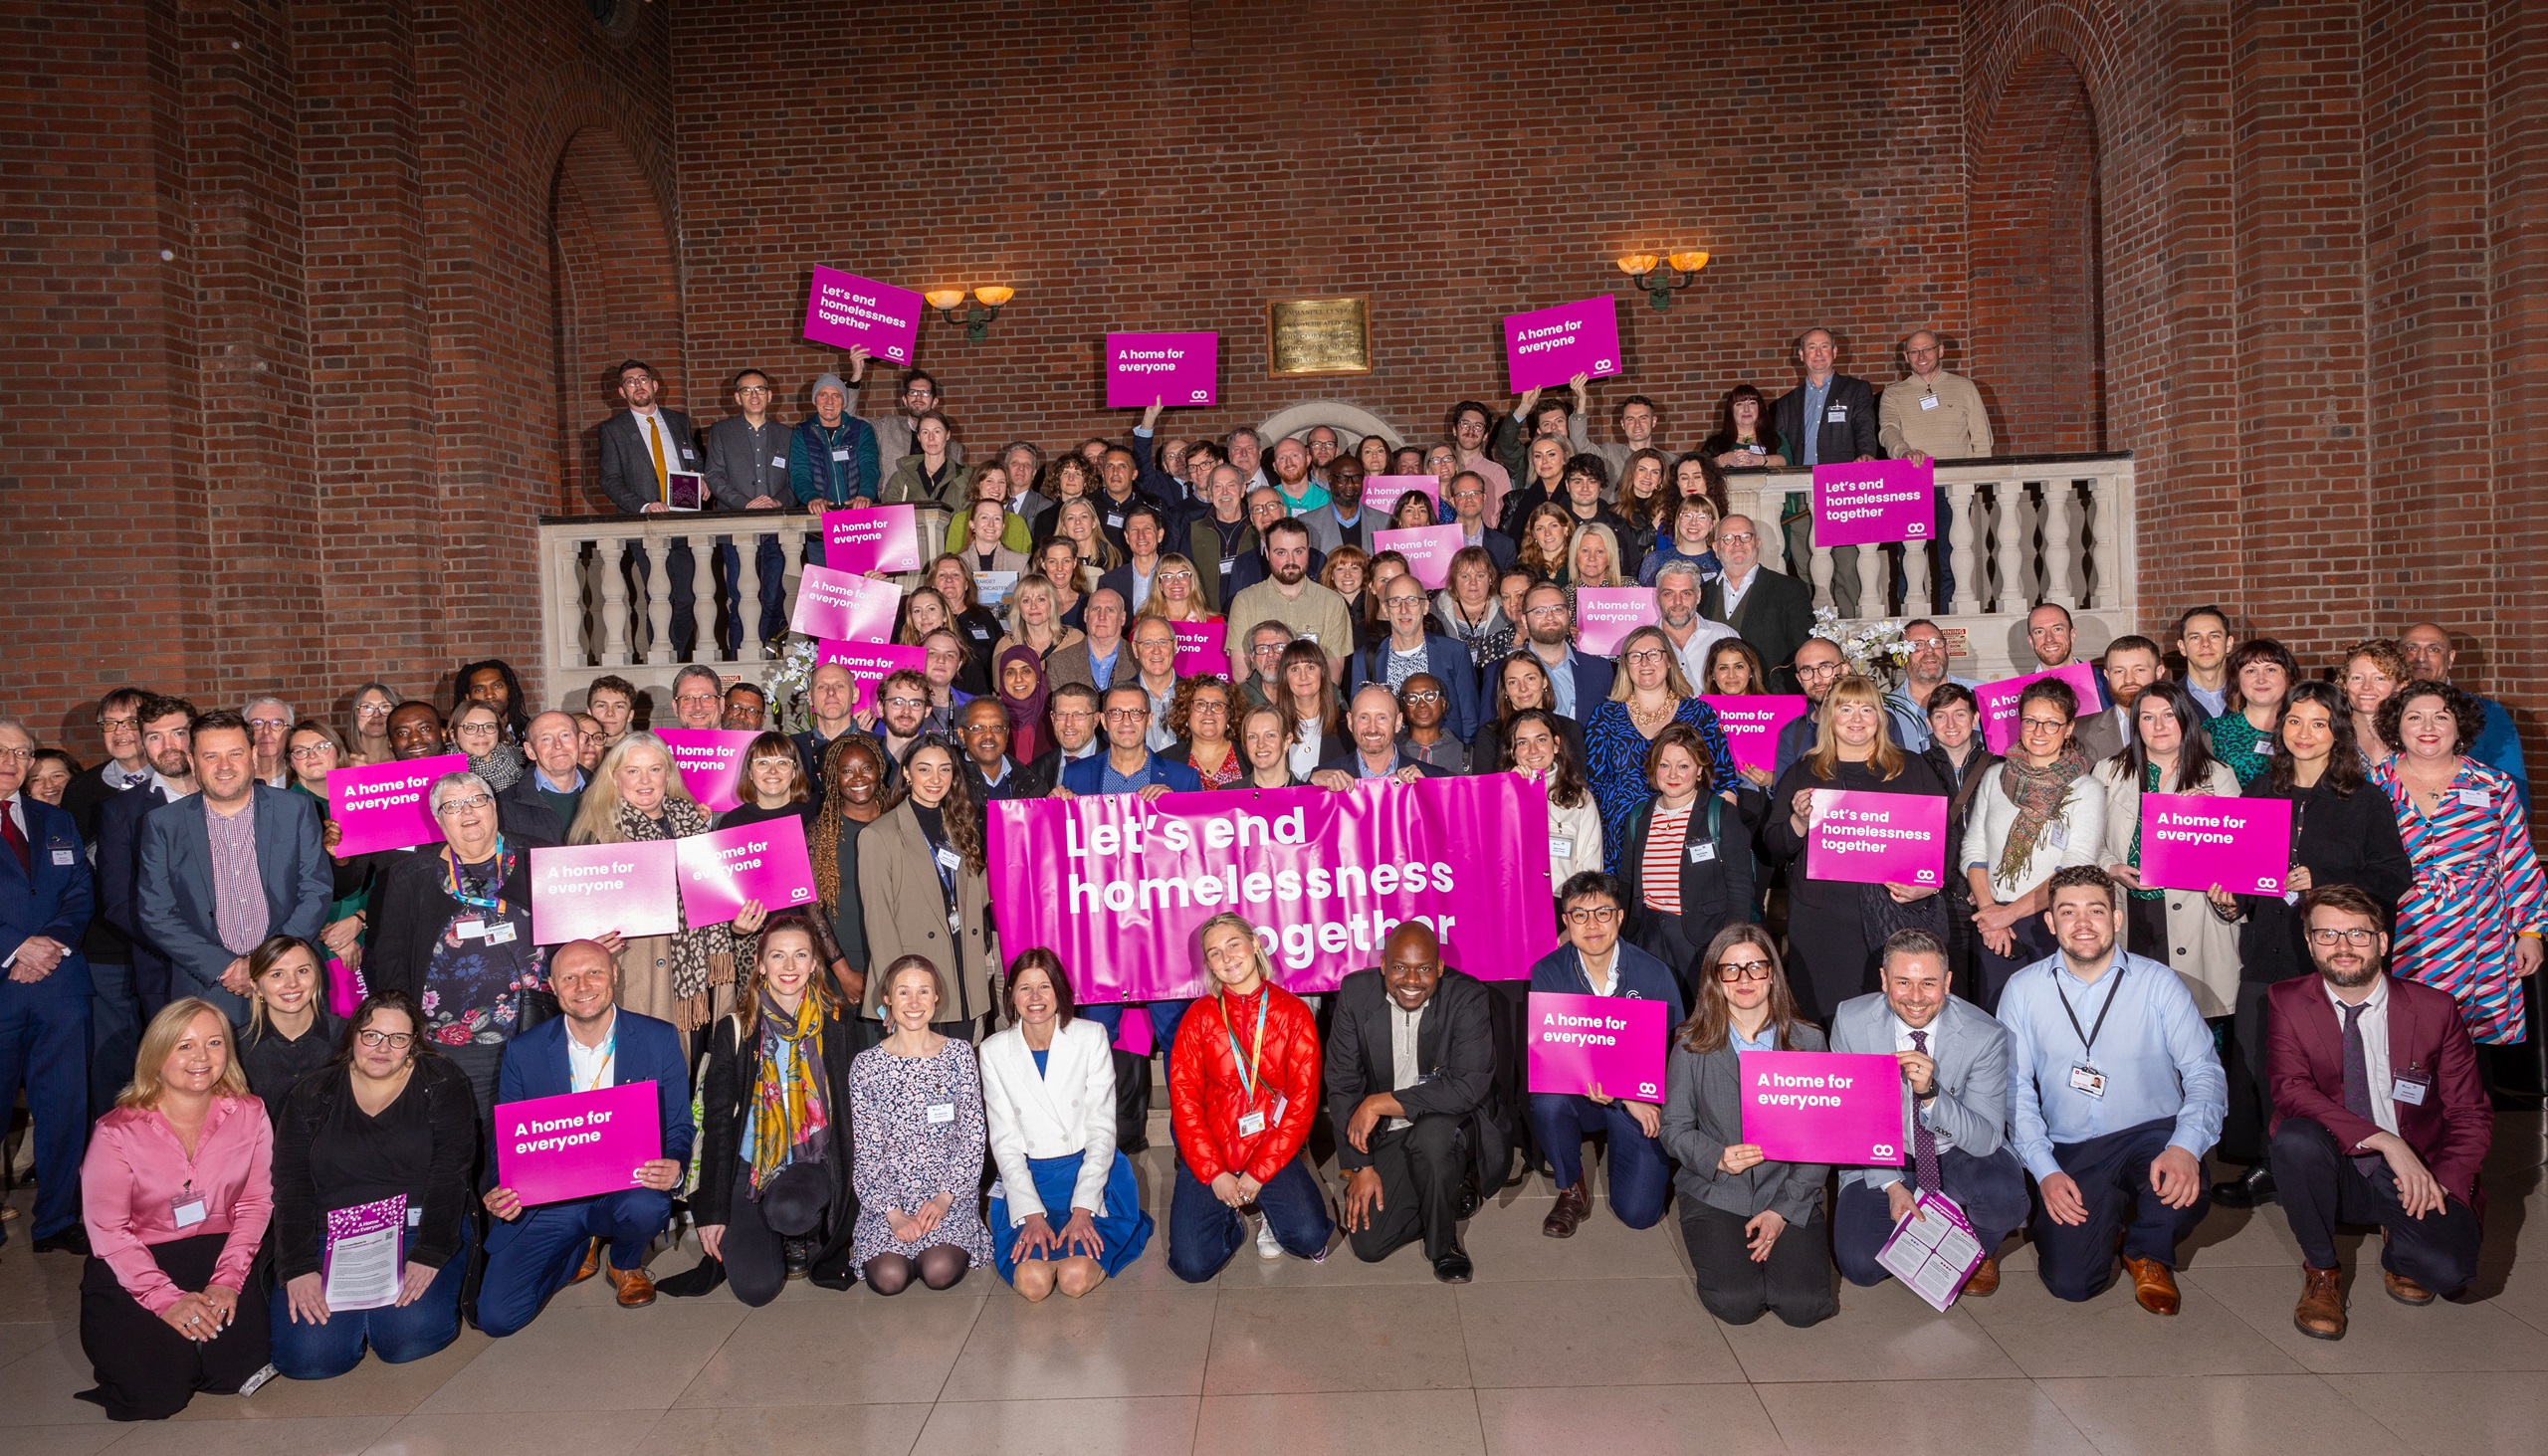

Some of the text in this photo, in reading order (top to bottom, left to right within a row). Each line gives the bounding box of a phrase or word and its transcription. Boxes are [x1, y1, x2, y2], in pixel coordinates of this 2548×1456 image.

[823, 284, 876, 307] Let's end
[819, 309, 870, 331] together
[821, 297, 906, 328] homelessness
[1518, 320, 1582, 342] A home for
[1518, 336, 1575, 354] everyone
[1119, 349, 1184, 359] A home for
[1119, 363, 1175, 374] everyone
[1826, 478, 1884, 493] Let's end
[1826, 491, 1920, 506] homelessness
[1827, 507, 1883, 522] together
[833, 520, 888, 533] A home for
[834, 532, 882, 544] everyone
[1394, 542, 1422, 550] home
[811, 580, 819, 589] A
[822, 582, 853, 597] home
[1597, 601, 1628, 609] home
[1631, 601, 1645, 609] for
[1587, 613, 1638, 623] everyone
[1194, 634, 1208, 642] for
[840, 655, 874, 666] home
[876, 658, 893, 668] for
[1991, 698, 2000, 708] A
[1720, 710, 1774, 720] home for
[677, 745, 714, 756] home
[716, 746, 735, 757] for
[344, 776, 429, 797] A home for
[345, 792, 419, 811] everyone
[1823, 808, 1889, 823] Let's end
[2157, 813, 2246, 829] A home for
[1066, 806, 1306, 857] Let's end
[1822, 823, 1931, 841] homelessness
[2157, 829, 2233, 846] everyone
[747, 841, 768, 853] for
[1821, 838, 1887, 853] together
[547, 861, 635, 879] A home for
[548, 879, 624, 895] everyone
[1068, 860, 1454, 914] homelessness
[1544, 1013, 1627, 1030] A home for
[1543, 1032, 1616, 1047] everyone
[1758, 1073, 1853, 1089] A home for
[1758, 1094, 1841, 1110] everyone
[515, 1110, 613, 1137] A home for
[516, 1131, 601, 1154] everyone
[360, 1223, 384, 1232] Everyone
